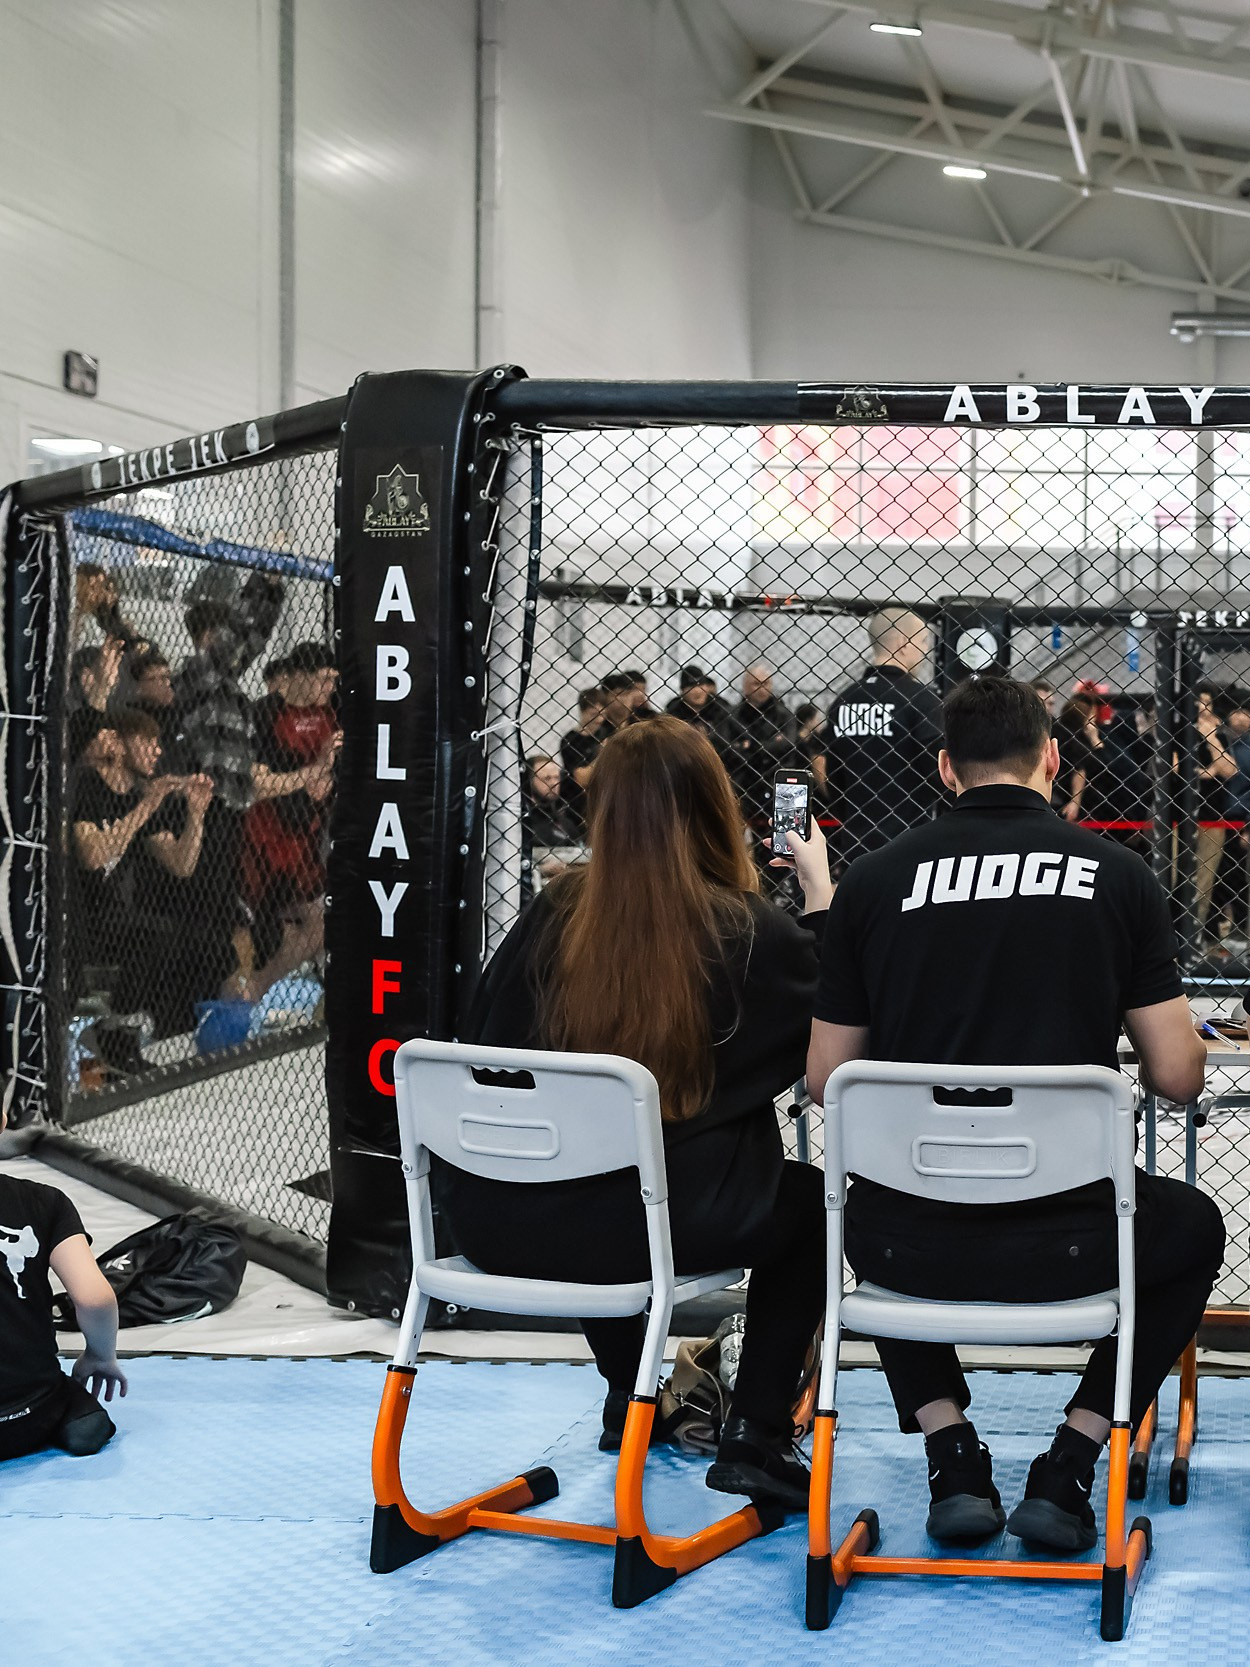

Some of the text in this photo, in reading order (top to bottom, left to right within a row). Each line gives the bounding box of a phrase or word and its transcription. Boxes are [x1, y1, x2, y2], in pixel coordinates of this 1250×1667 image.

[943, 385, 1215, 425] ABLAY
[117, 431, 229, 486] JEKPE JEK
[833, 703, 895, 738] JUDGE
[368, 565, 416, 937] ABLAY
[901, 852, 1100, 912] JUDGE
